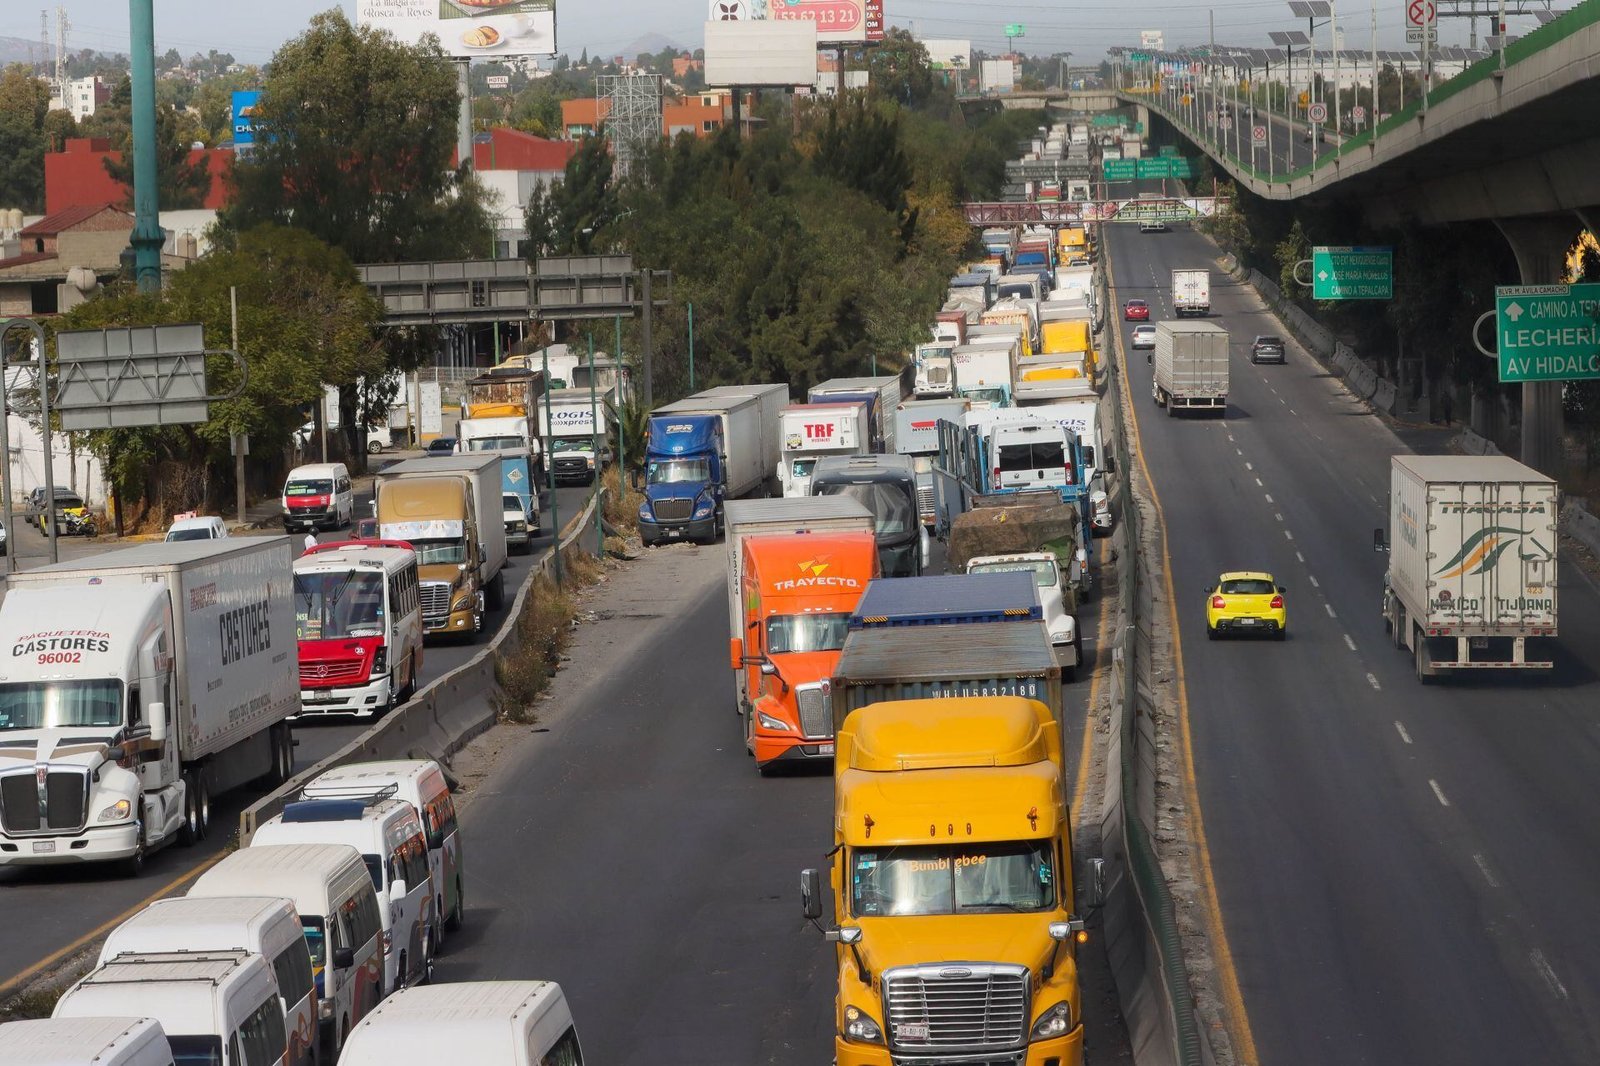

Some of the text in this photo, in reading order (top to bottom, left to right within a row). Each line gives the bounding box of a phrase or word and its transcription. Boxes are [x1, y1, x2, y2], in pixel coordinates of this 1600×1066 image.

[407, 8, 433, 18] Reyes
[820, 10, 834, 23] 13
[840, 9, 854, 22] 21
[1331, 285, 1352, 295] CAMINO
[1359, 285, 1389, 296] TEPALCAPA
[1540, 285, 1567, 294] CAMACHO
[1530, 301, 1567, 319] CAMINO
[1570, 301, 1578, 317] A
[1504, 323, 1600, 348] LECHERÍ
[1507, 357, 1531, 375] AV
[804, 423, 834, 438] TRF
[1439, 501, 1546, 514] TRACASA
[774, 577, 857, 590] TRAYECTO
[1500, 598, 1552, 610] TIJUANA
[18, 630, 111, 641] PAQUETERIA
[220, 600, 271, 666] CASTORES
[12, 638, 109, 657] CASTORES
[38, 652, 81, 664] 96002
